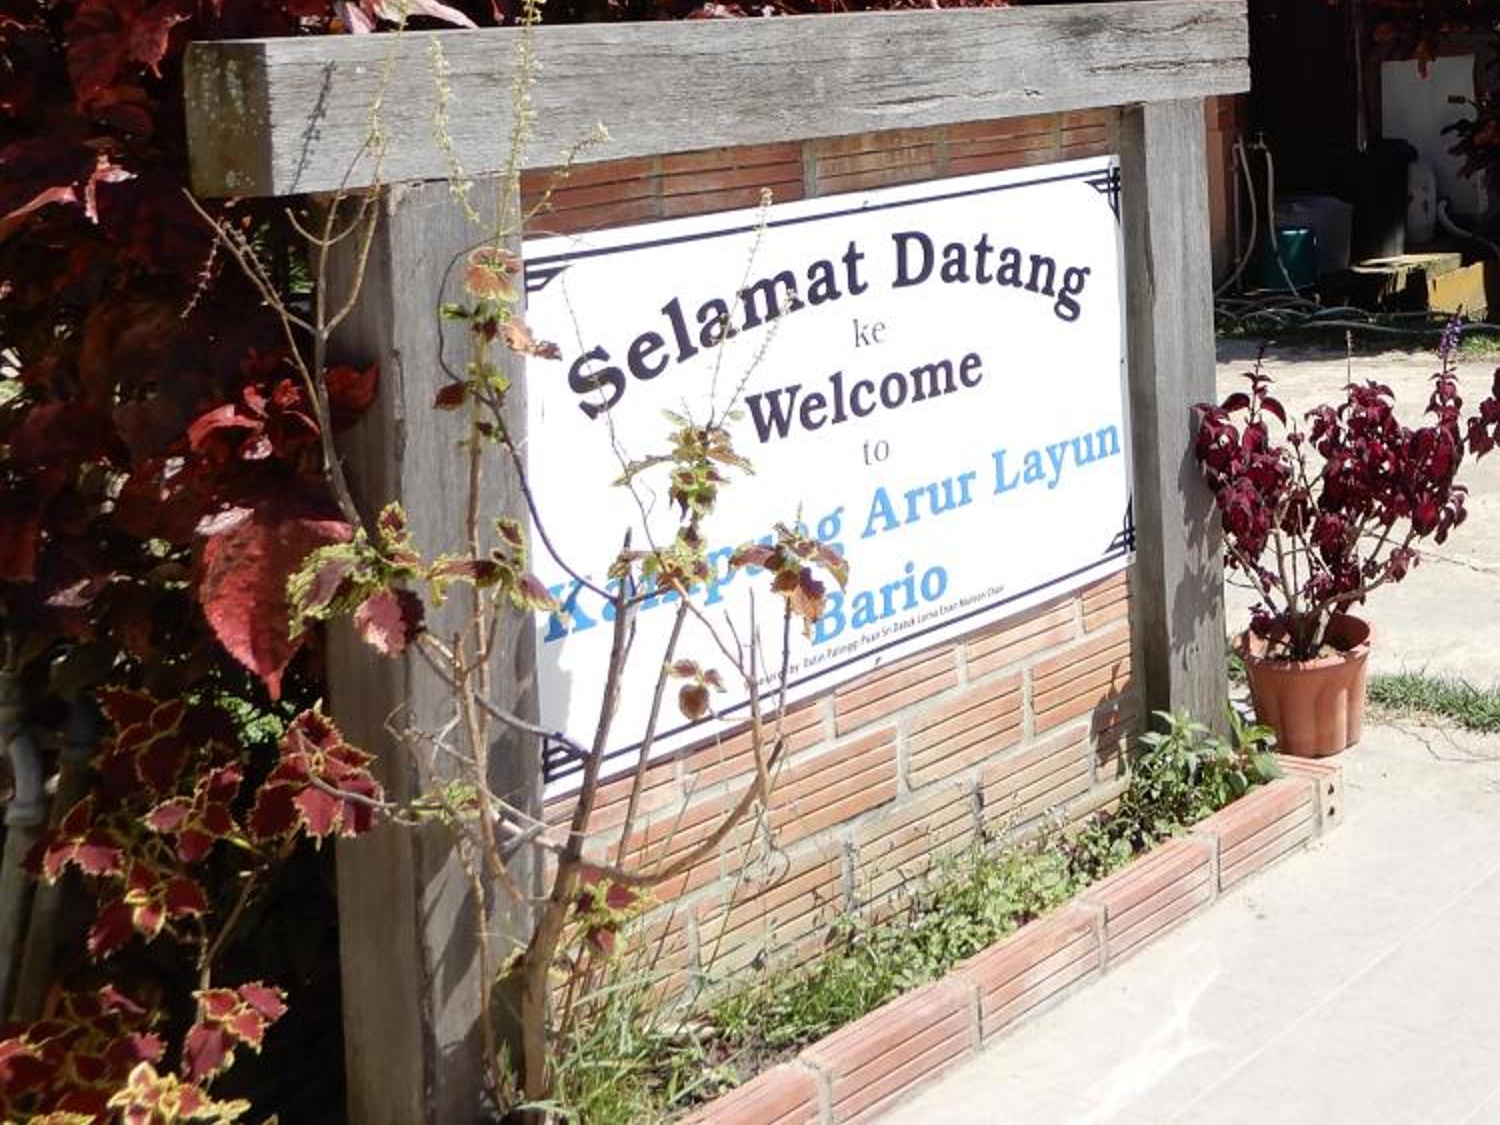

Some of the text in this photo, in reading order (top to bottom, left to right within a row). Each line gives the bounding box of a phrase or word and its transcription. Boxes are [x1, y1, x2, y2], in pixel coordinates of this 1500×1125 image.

[567, 230, 1091, 421] Selamat Datang
[851, 317, 888, 350] ke
[744, 352, 984, 444] Welcome
[859, 469, 978, 540] Arur
[991, 420, 1121, 498] Layun
[862, 438, 891, 466] to
[810, 562, 950, 647] Bario
